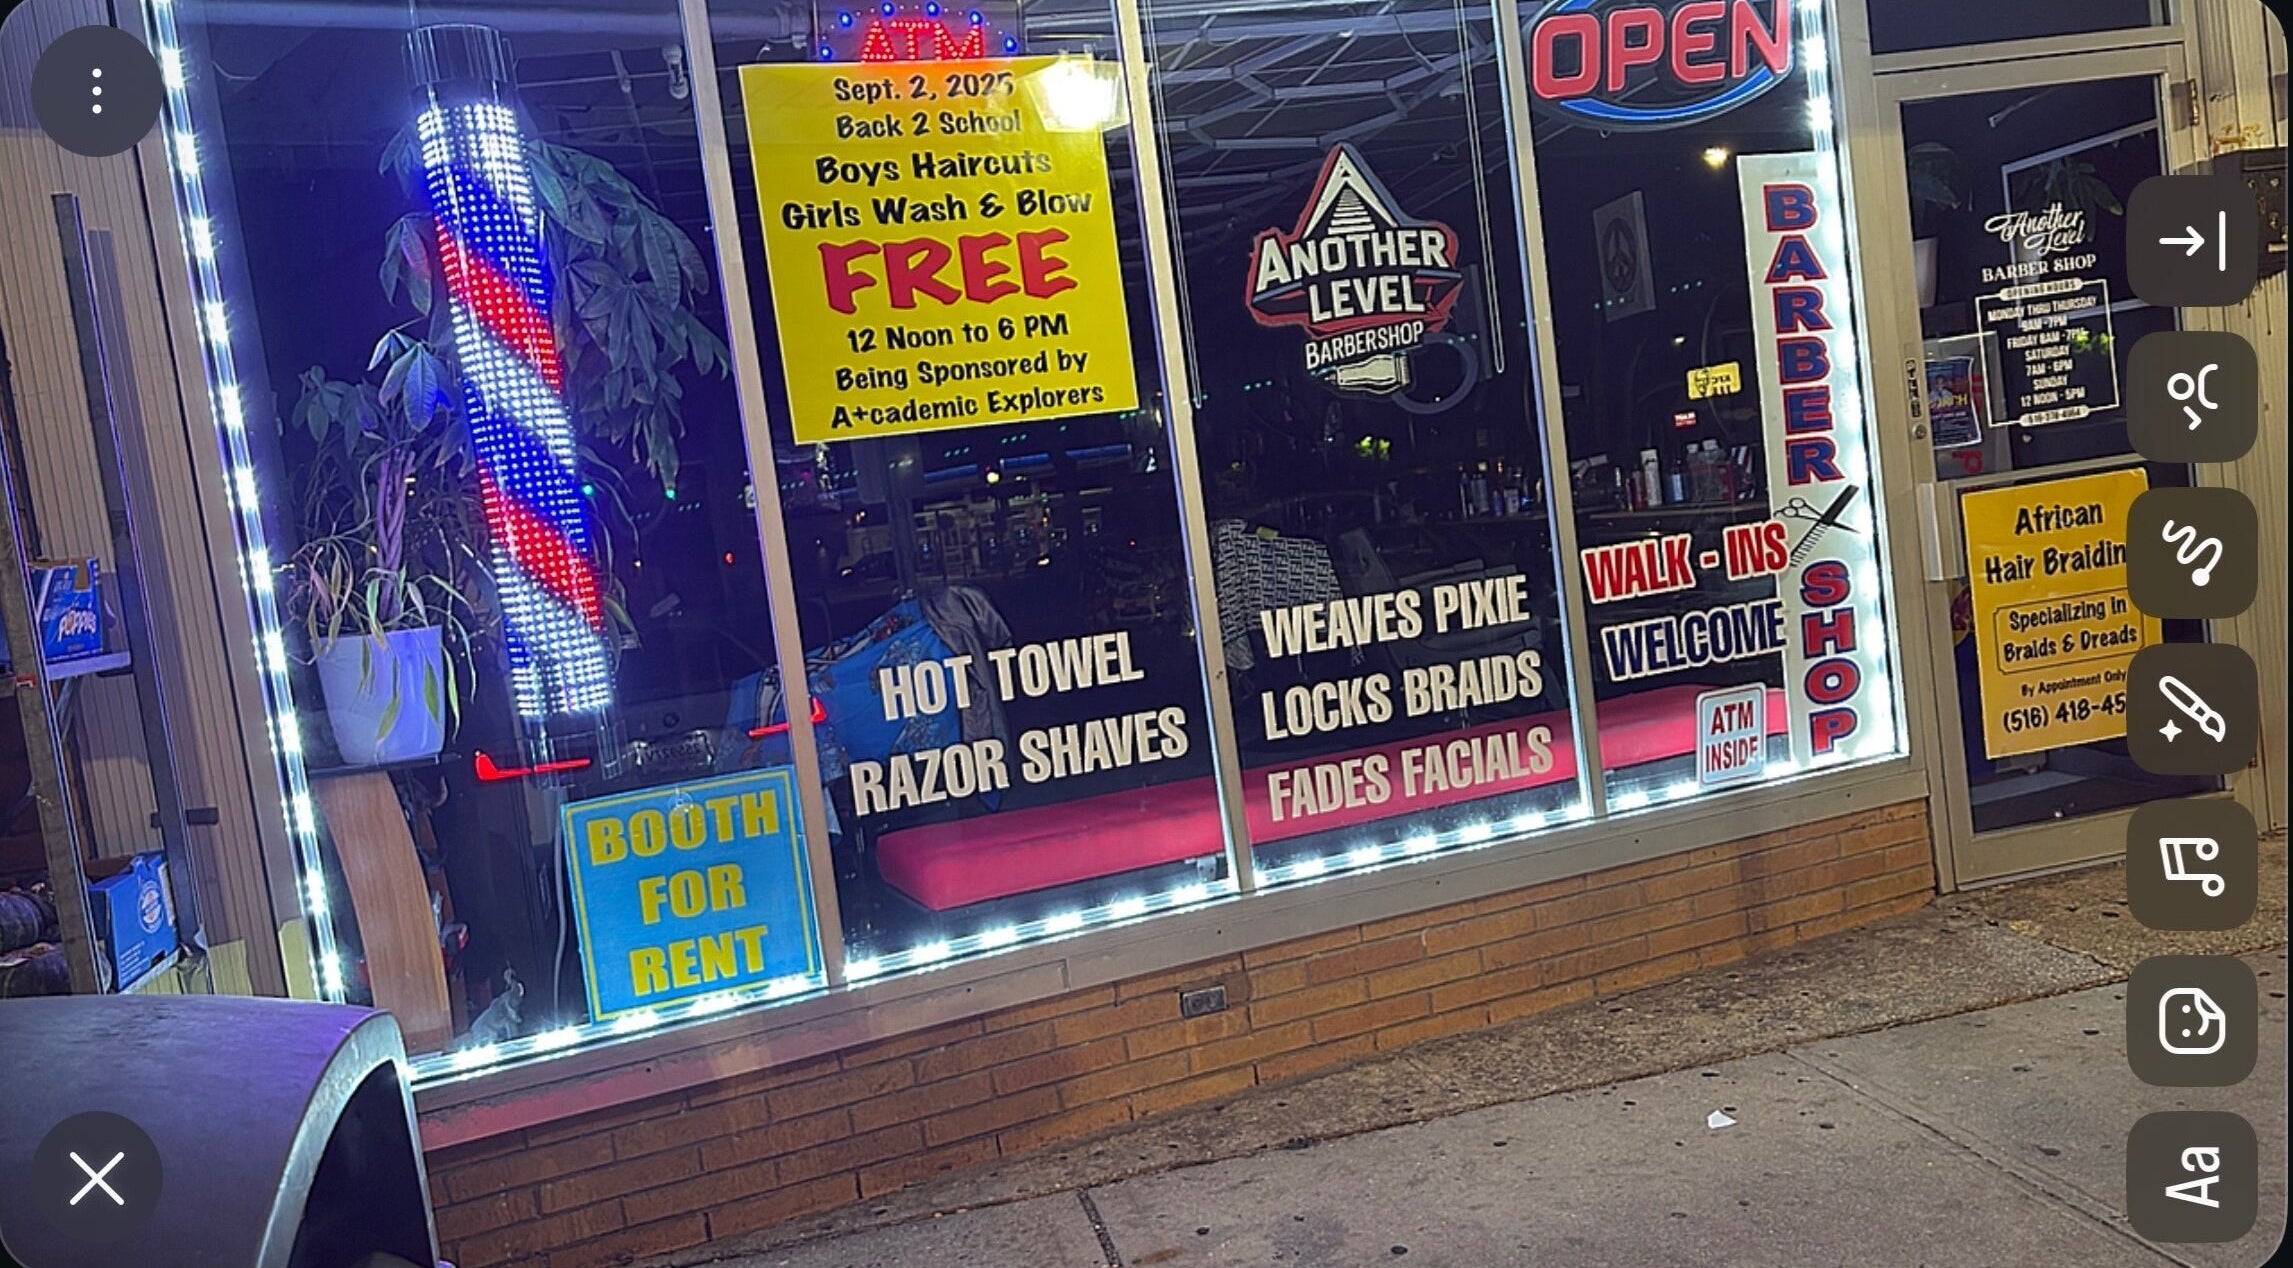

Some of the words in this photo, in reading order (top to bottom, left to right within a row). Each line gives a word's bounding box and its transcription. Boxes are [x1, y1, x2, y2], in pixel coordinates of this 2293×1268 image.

[861, 20, 984, 62] ATM
[1532, 0, 1791, 99] OPEN
[834, 74, 901, 104] Sept.
[909, 76, 937, 101] 2,
[946, 72, 1014, 98] 2025
[836, 113, 903, 139] Back
[913, 112, 930, 136] 2
[939, 109, 1021, 135] School
[816, 155, 900, 186] Boys
[912, 150, 1051, 180] Haircuts
[782, 199, 861, 230] Girls
[872, 194, 968, 224] Wash
[979, 193, 1005, 219] &
[1016, 189, 1091, 217] Blow
[1984, 202, 2084, 242] Another
[2023, 219, 2085, 256] Level
[817, 228, 1078, 315] FREE
[1256, 226, 1450, 292] ANOTHER
[1982, 259, 2049, 283] BARBER
[2053, 253, 2097, 272] SHOP
[1309, 274, 1425, 322] LEVEL
[1987, 306, 2025, 322] MONDAY
[2052, 295, 2097, 312] THURSDAY
[846, 328, 876, 354] 12
[886, 325, 953, 351] Noon
[962, 322, 988, 345] to
[998, 318, 1014, 340] 6
[1024, 314, 1068, 338] PM
[1305, 320, 1424, 369] BARBERSHOP
[1763, 184, 1845, 485] BARBER
[2007, 335, 2038, 349] FRIDAY
[2024, 344, 2070, 362] SATURDAY
[835, 366, 907, 393] Being
[917, 349, 1047, 386] Sponsored
[1056, 349, 1088, 377] by
[2025, 363, 2046, 377] 7AM
[2033, 374, 2068, 391] SUNDAY
[831, 395, 978, 429] A+cademic
[988, 385, 1104, 419] Explorers
[2020, 395, 2032, 407] 12
[2033, 391, 2059, 406] NOON
[2015, 503, 2103, 535] African
[1582, 535, 1695, 602] WALK
[1724, 521, 1789, 579] INS
[1984, 554, 2035, 585] Hair
[2043, 541, 2126, 577] Braidin
[1260, 589, 1423, 658] WEAVES
[1433, 575, 1530, 633] PIXIE
[2009, 599, 2105, 632] Specializing
[1602, 600, 1787, 681] WELCOME
[1800, 560, 1861, 756] SHOP
[2003, 634, 2056, 663] Braids
[2063, 634, 2076, 653] &
[2080, 624, 2137, 651] Dreads
[879, 656, 972, 721] HOT
[988, 631, 1144, 701] TOWEL
[1262, 673, 1392, 741] LOCKS
[1403, 649, 1543, 717] BRAIDS
[2021, 683, 2035, 698] By
[2038, 674, 2101, 694] Appointment
[2104, 670, 2126, 683] Only
[1711, 700, 1754, 735] ATM
[2003, 705, 2049, 733] (516)
[2055, 692, 2126, 723] 418-45
[850, 739, 1010, 817] RAZOR
[1019, 706, 1189, 783] SHAVES
[1267, 754, 1391, 822] FADES
[1401, 727, 1553, 798] FACIALS
[1705, 736, 1757, 773] INSIDE
[587, 790, 779, 867] BOOTH
[639, 863, 746, 926] FOR
[629, 925, 768, 997] RENT
